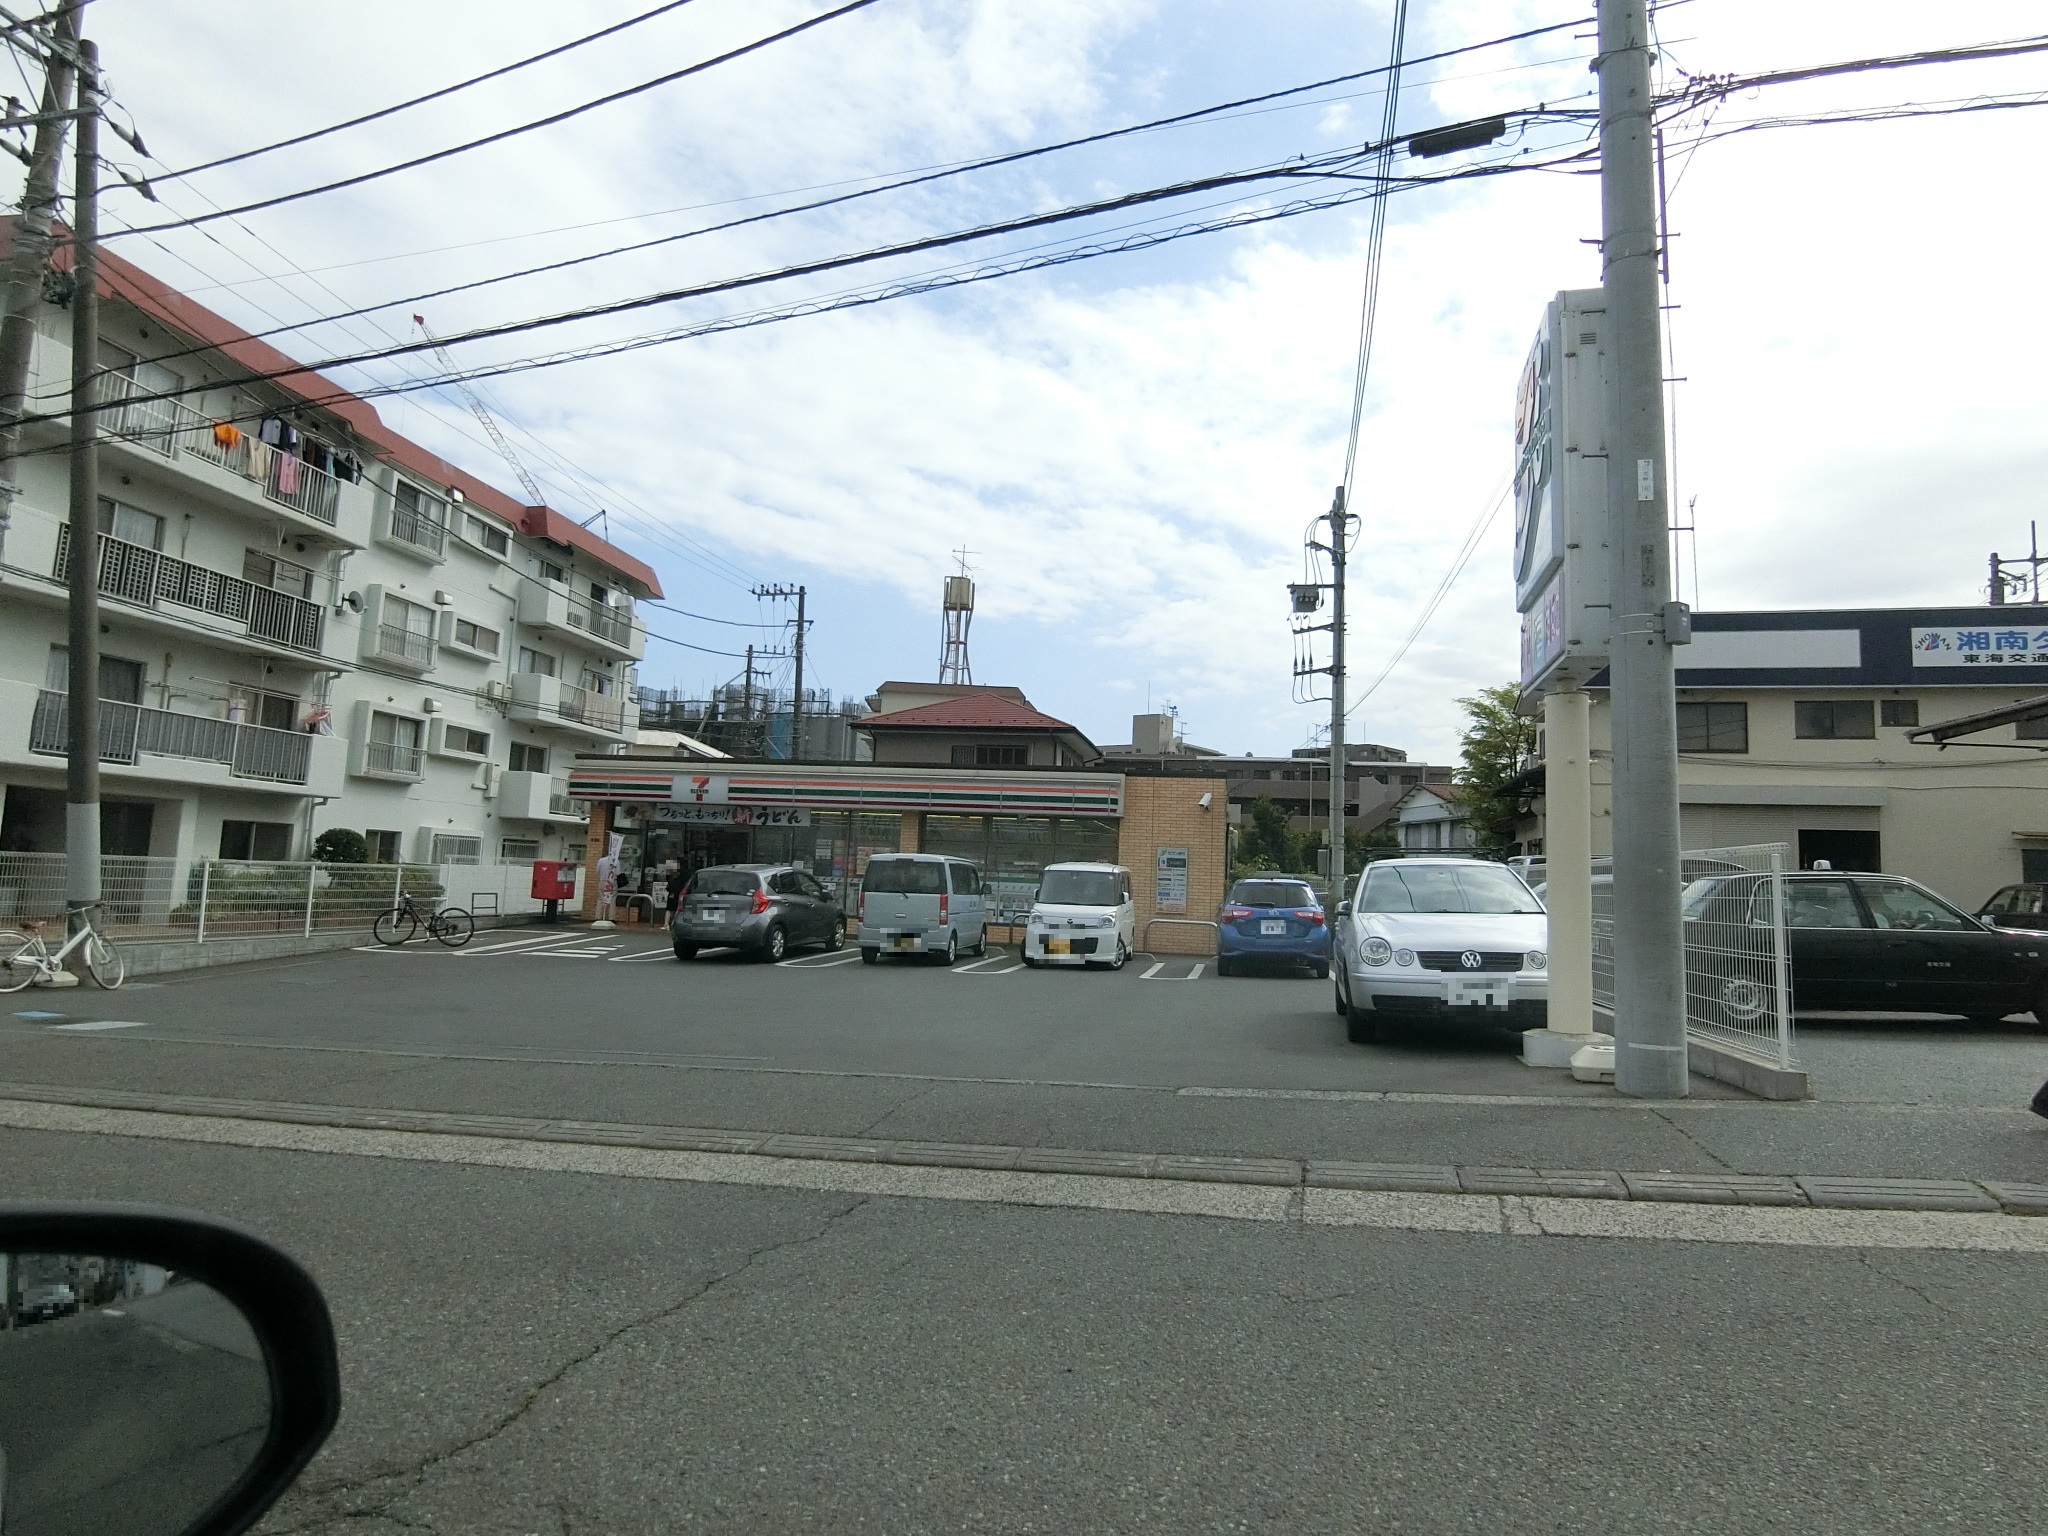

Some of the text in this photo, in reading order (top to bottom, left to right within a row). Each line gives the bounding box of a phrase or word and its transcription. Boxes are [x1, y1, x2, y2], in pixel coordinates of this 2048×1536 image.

[1962, 653, 2048, 664] 東海交通
[692, 777, 710, 801] 7
